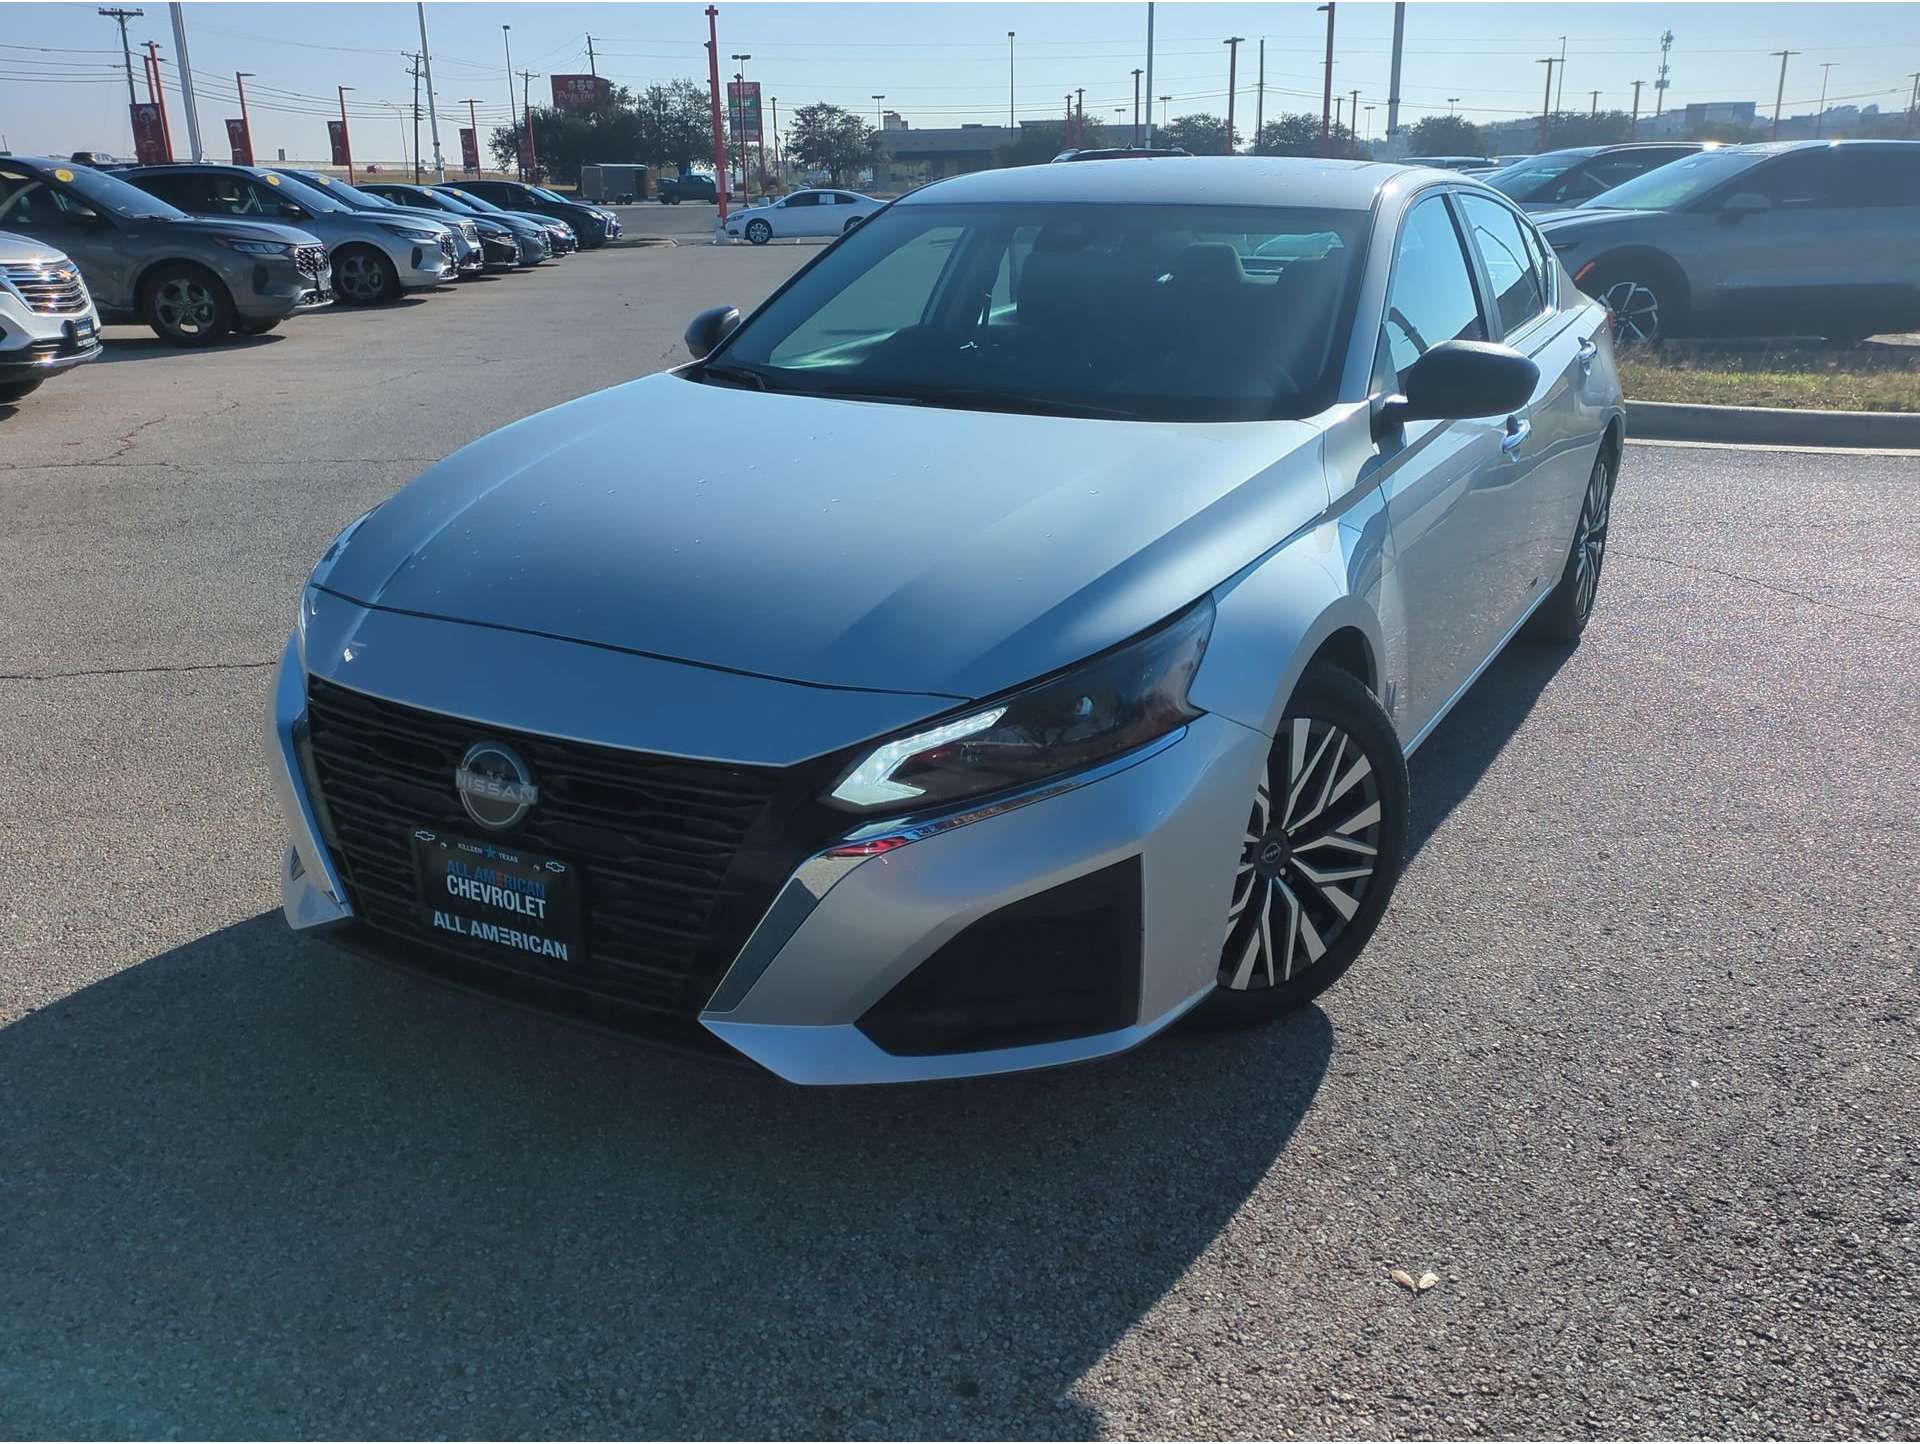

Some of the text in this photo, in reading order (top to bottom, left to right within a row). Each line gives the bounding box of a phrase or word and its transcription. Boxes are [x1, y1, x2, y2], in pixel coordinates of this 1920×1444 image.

[456, 769, 536, 801] NISSAN
[498, 852, 519, 863] TEXAS
[446, 874, 546, 919] CHEVROLET
[447, 861, 545, 897] ALL AMERICAN
[433, 910, 568, 961] ALL AMERICAN
